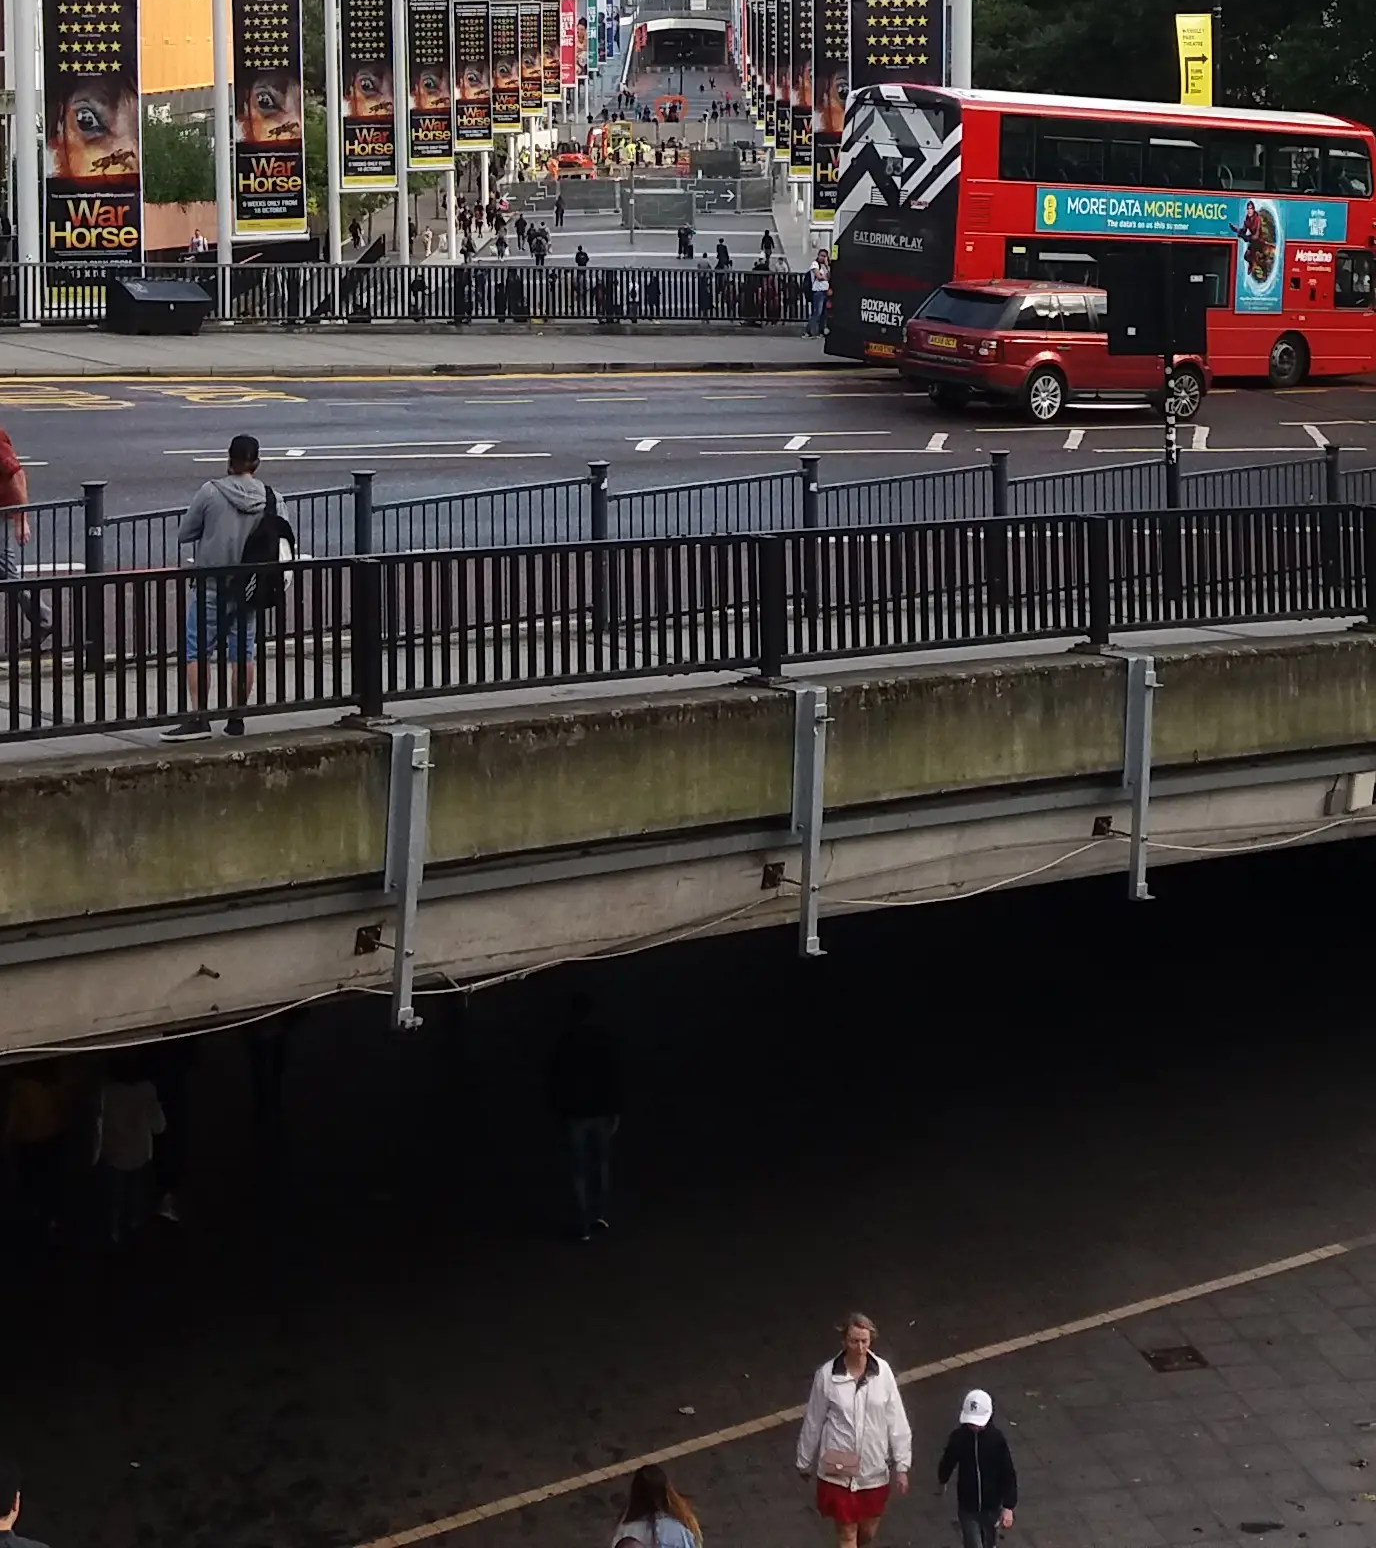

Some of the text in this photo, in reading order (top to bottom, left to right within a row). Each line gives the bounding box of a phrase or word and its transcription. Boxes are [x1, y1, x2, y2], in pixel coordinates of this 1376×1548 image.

[464, 107, 487, 117] War
[419, 118, 447, 131] War
[458, 116, 490, 126] Horse
[355, 128, 388, 143] War
[412, 128, 451, 141] Horse
[346, 140, 393, 155] Horse
[251, 157, 296, 176] War
[238, 172, 302, 192] Horse
[67, 200, 129, 227] War
[1067, 197, 1227, 220] MORE DATA MORE MAGIC
[1154, 222, 1165, 230] this
[50, 221, 138, 248] Horse
[870, 232, 898, 246] DRINK.
[900, 236, 923, 249] PLAY.
[1295, 250, 1332, 263] Metroline
[861, 298, 901, 314] BOXPARK
[861, 311, 904, 327] WEMBLEY
[126, 386, 308, 403] BUS
